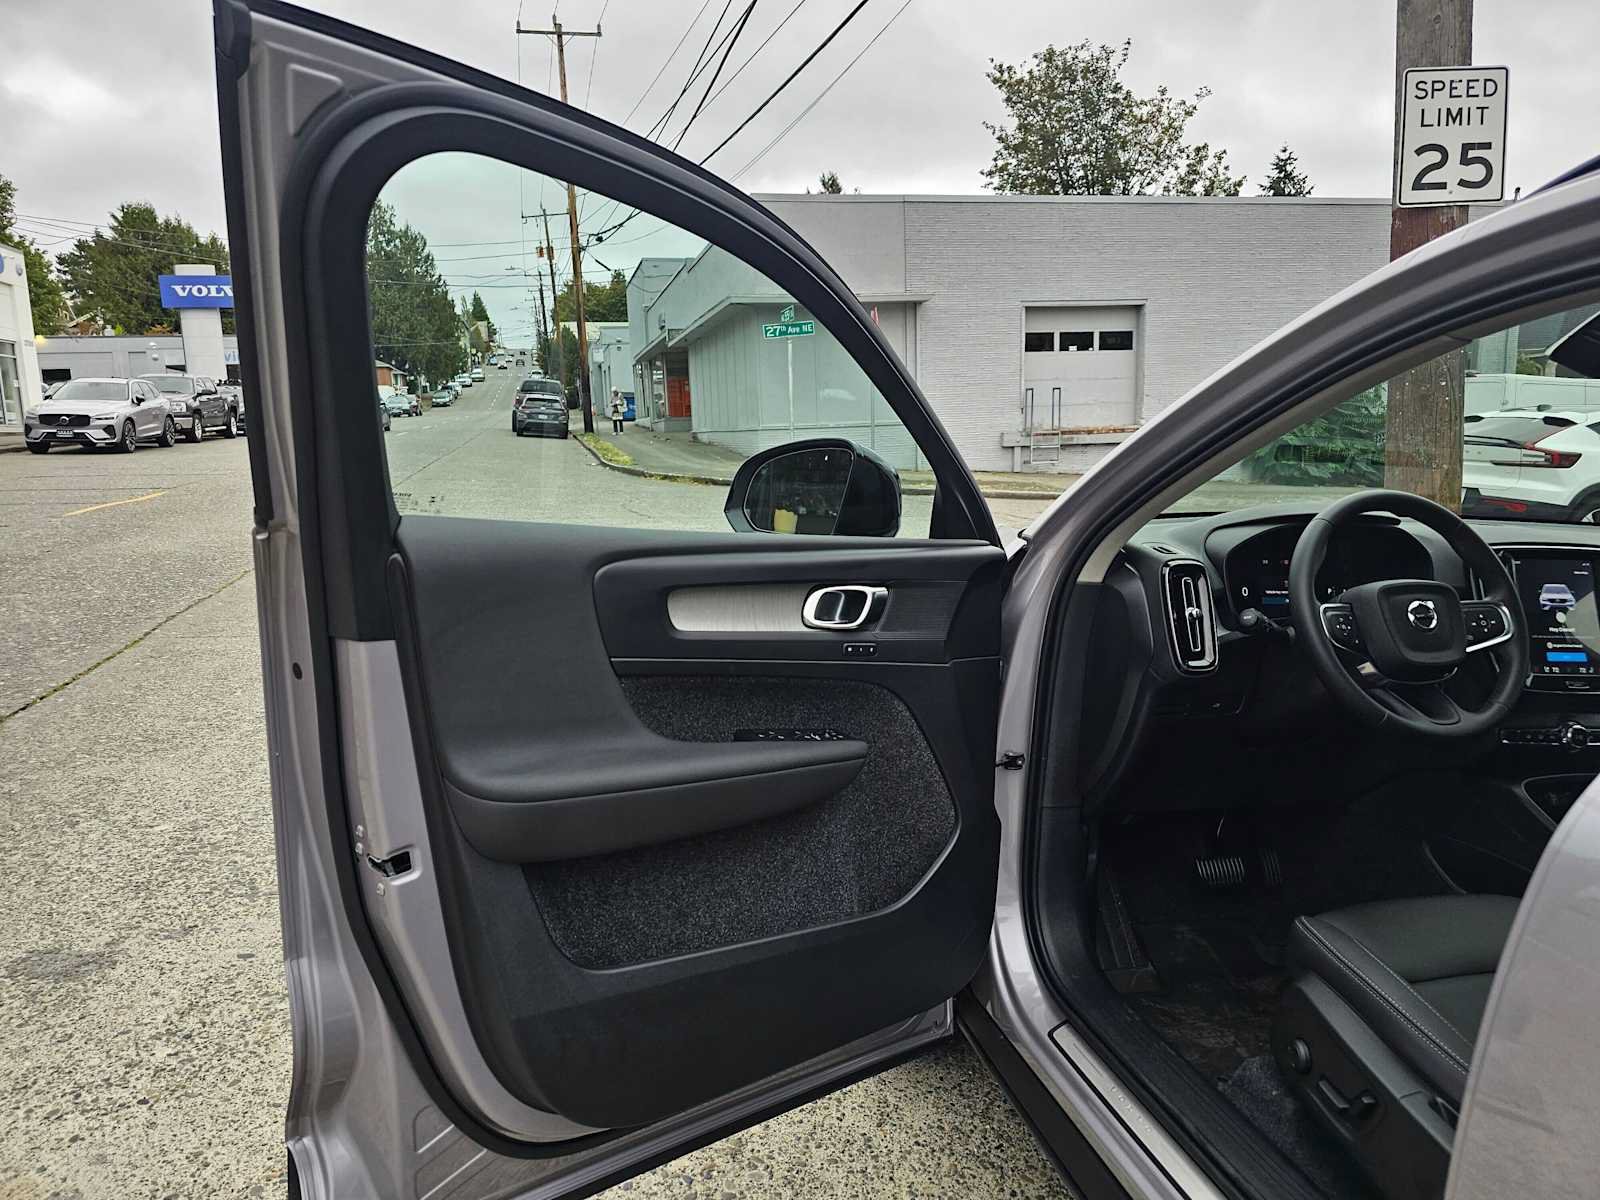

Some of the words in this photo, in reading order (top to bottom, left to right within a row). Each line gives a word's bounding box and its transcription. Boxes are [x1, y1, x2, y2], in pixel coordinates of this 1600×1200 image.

[1414, 78, 1498, 100] SPEED
[1420, 106, 1490, 128] LIMIT
[1411, 141, 1494, 191] 25
[802, 323, 813, 332] NE
